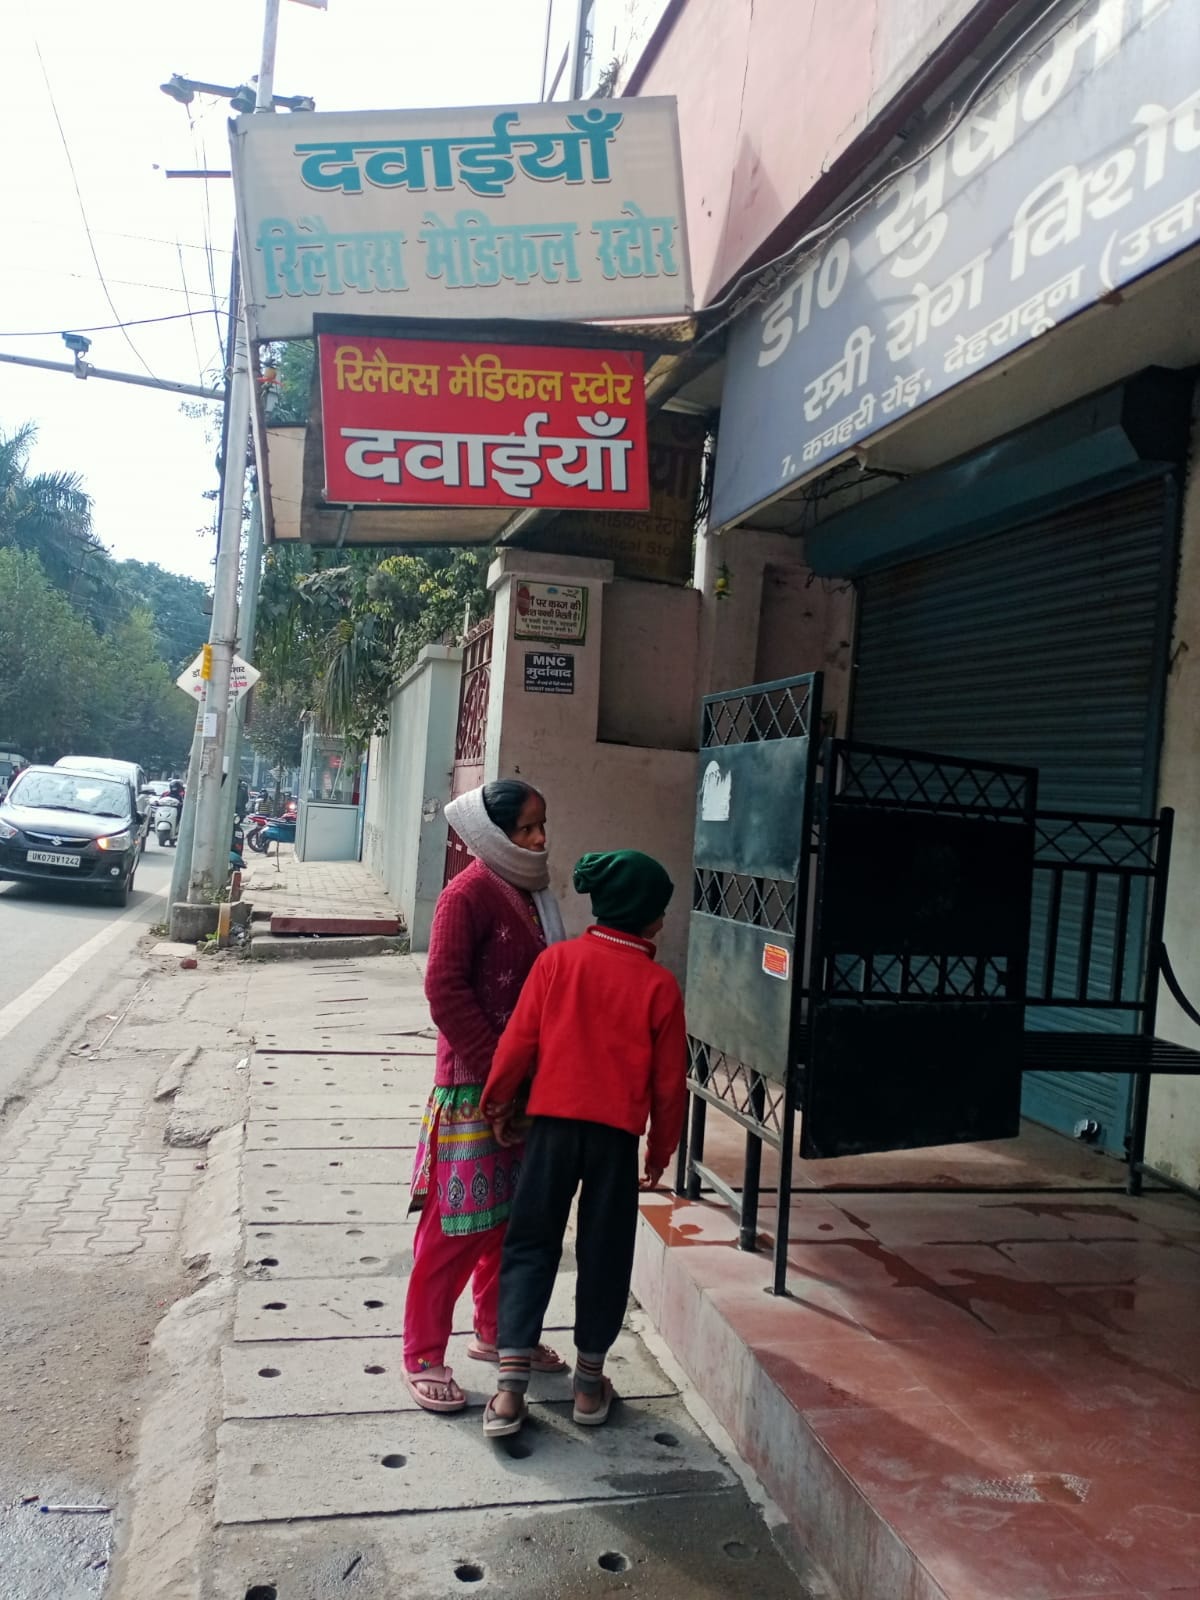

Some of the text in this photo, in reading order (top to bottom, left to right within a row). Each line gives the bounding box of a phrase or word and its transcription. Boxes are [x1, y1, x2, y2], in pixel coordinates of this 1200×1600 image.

[294, 108, 623, 196] दवाईयाँ
[418, 208, 581, 288] मेडिकल
[591, 200, 680, 281] स्टोर
[334, 345, 634, 405] रिलैक्स मेडिकल स्टोर
[803, 325, 876, 422] स्त्री
[886, 248, 992, 362] रोग
[803, 393, 876, 462] कचहरी
[943, 262, 1086, 373] देहरादून
[340, 410, 632, 498] दवाईयाँ
[533, 656, 566, 667] MNC
